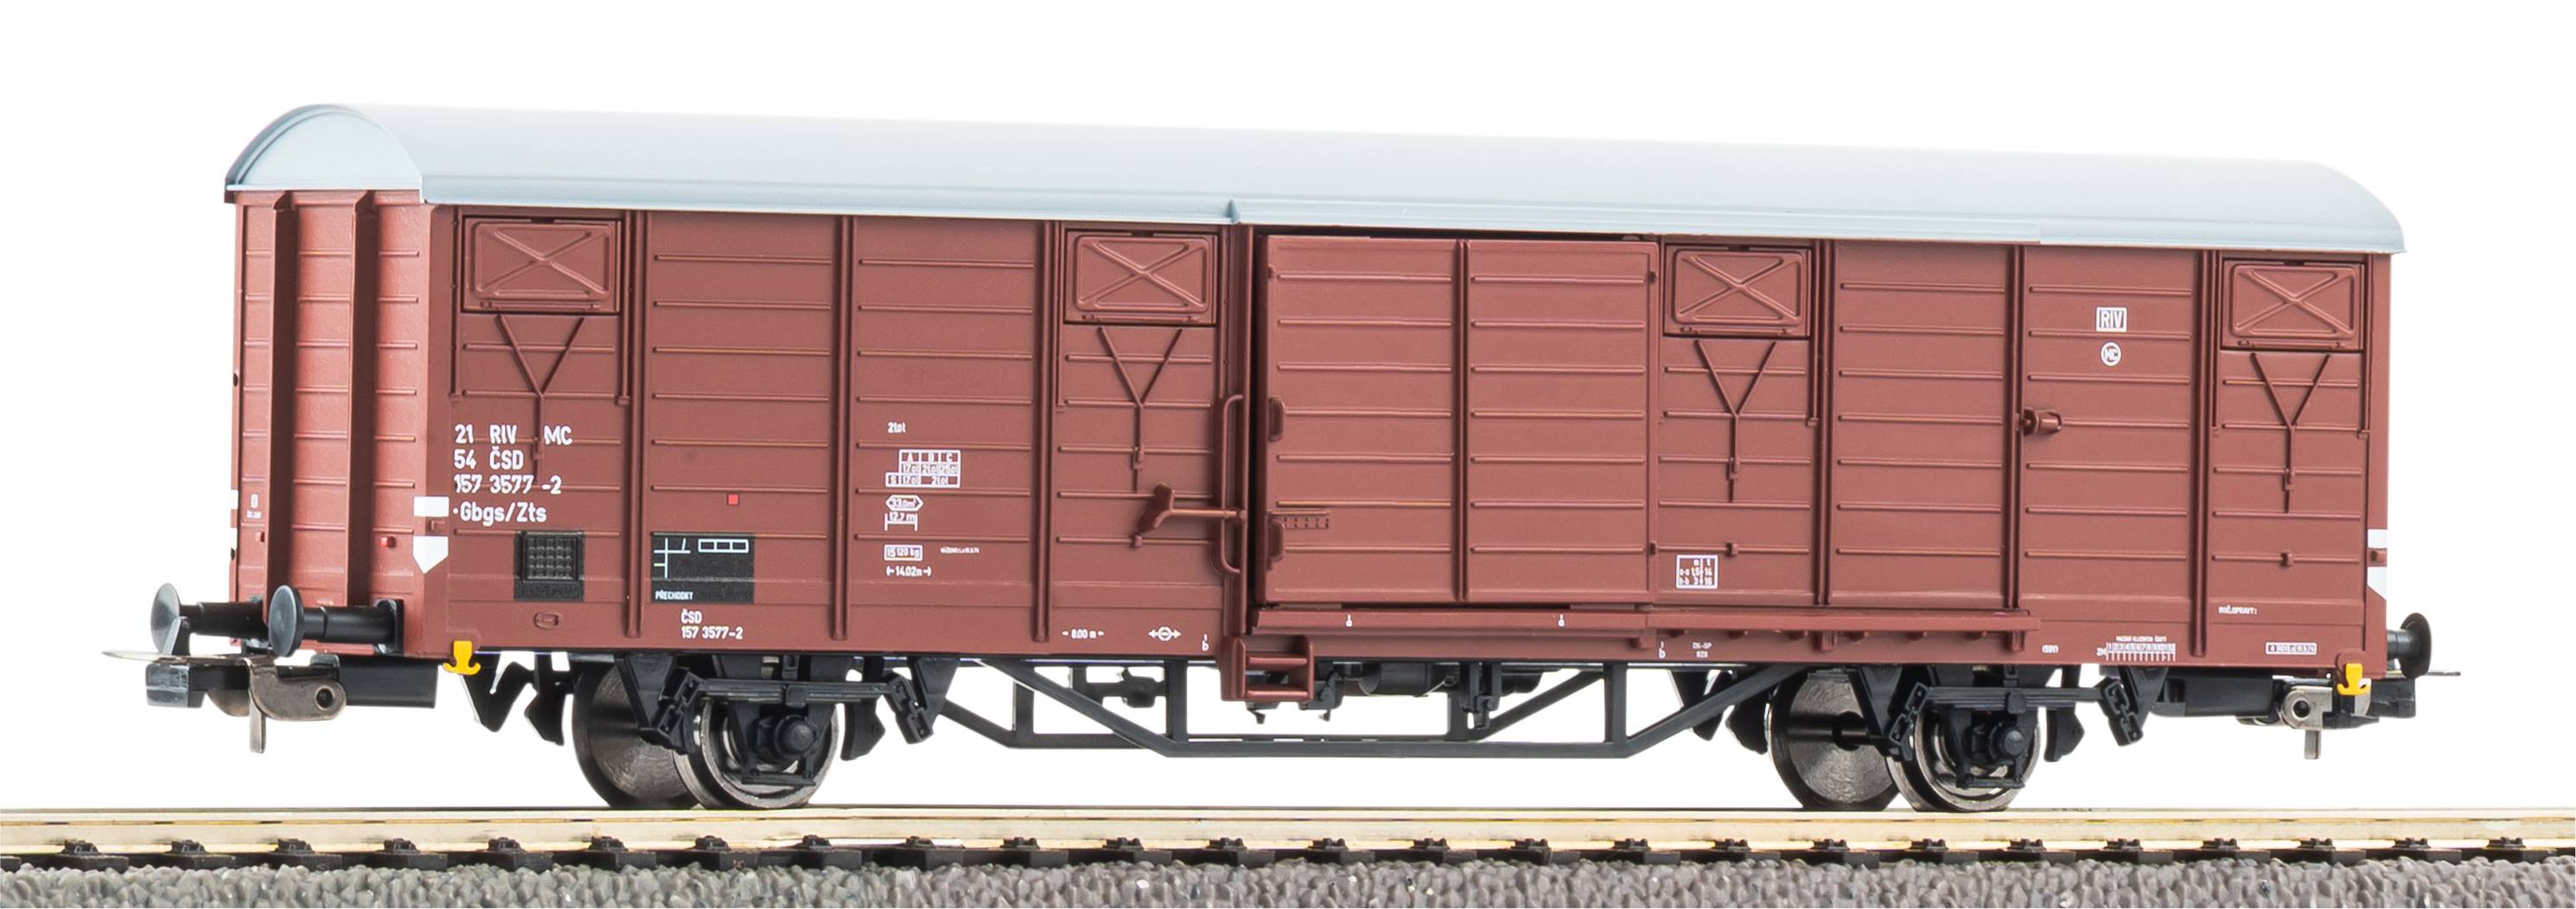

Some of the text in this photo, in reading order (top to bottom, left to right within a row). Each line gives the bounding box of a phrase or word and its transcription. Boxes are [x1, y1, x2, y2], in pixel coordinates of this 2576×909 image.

[2101, 310, 2123, 328] RIV
[455, 423, 573, 445] 21 RIV MC
[454, 445, 524, 470] 54 ČSD
[454, 474, 482, 493] 157
[489, 474, 534, 494] 3577
[681, 608, 702, 624] ČSD
[681, 626, 743, 639] 157 3577-2
